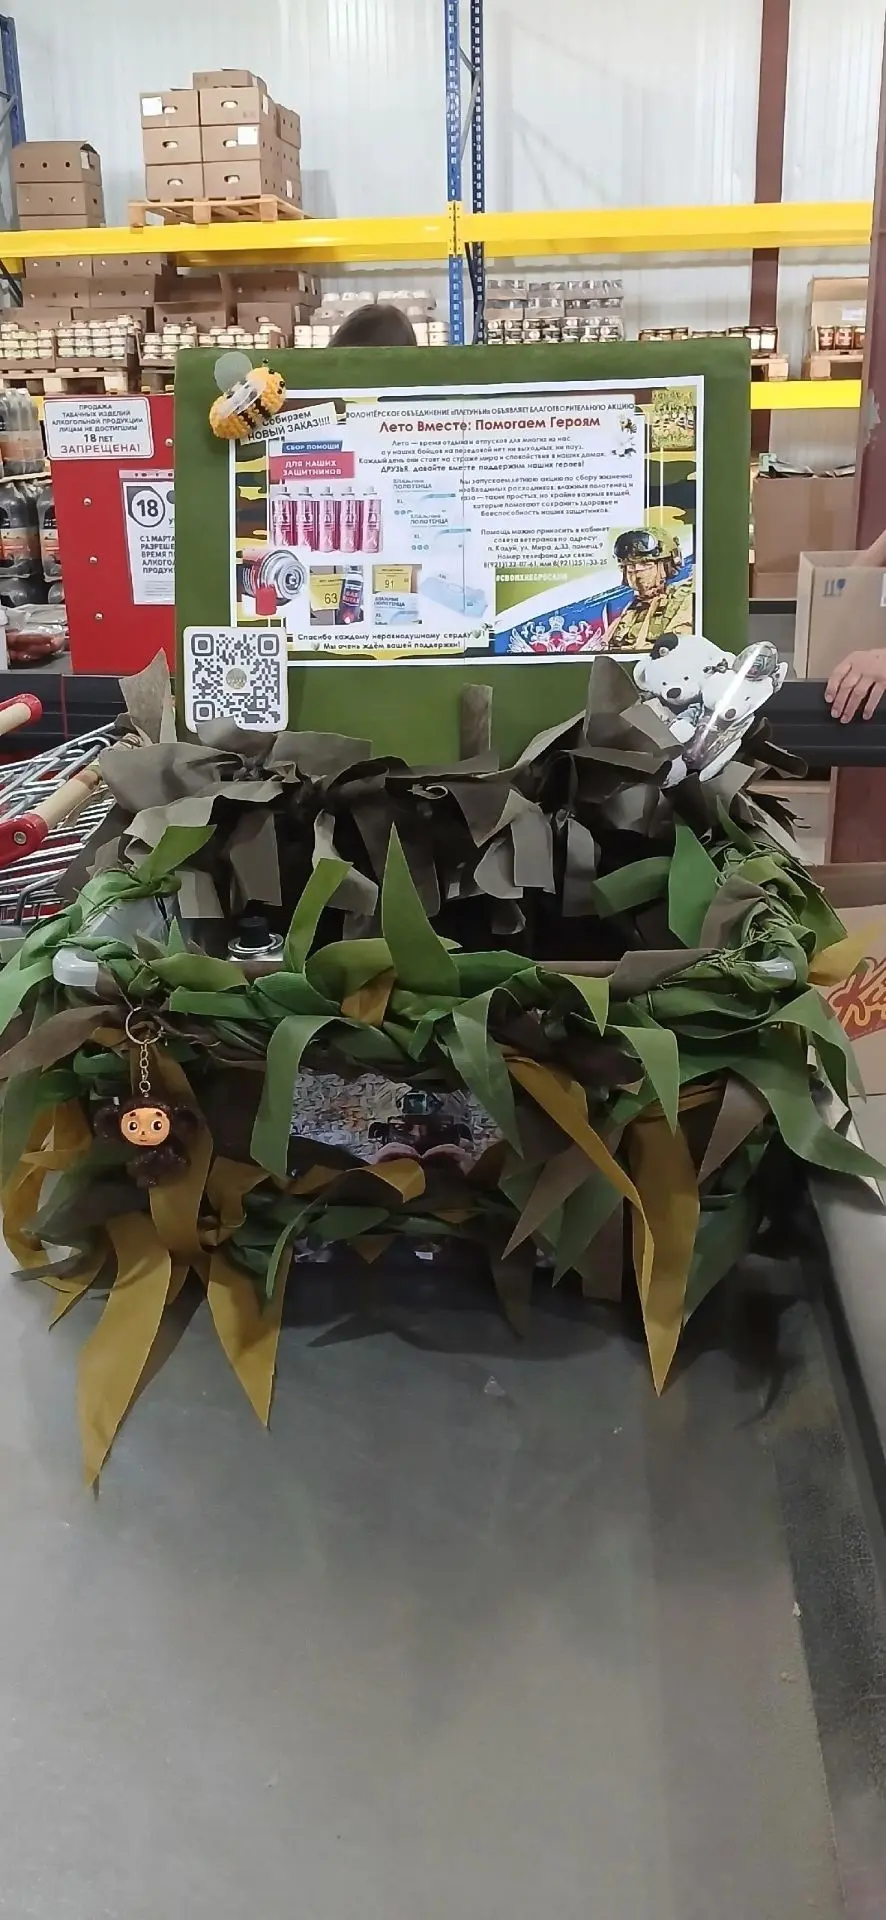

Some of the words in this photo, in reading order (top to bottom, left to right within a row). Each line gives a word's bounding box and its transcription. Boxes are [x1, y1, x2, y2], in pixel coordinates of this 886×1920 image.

[492, 406, 528, 414] ОБЪЯВЛЯЕТ
[529, 404, 606, 412] БЛАГОТВОРИТЕЛЬНУЮ
[248, 426, 286, 440] НОВЫЙ
[287, 416, 330, 433] ЗАКАЗ!!!!
[380, 421, 413, 433] Лето
[417, 420, 472, 432] Вместе:
[476, 418, 546, 430] Помогаем
[550, 416, 600, 430] Героям
[84, 434, 96, 443] 18
[60, 444, 140, 454] ЗАПРЕЩЕНА!
[412, 464, 446, 472] давайте
[555, 460, 585, 469] героев!
[282, 468, 342, 476] ЗАЩИТНИКОВ
[136, 499, 158, 517] 18
[522, 552, 558, 560] телефона
[384, 579, 394, 589] 91
[324, 592, 338, 604] 63
[298, 634, 332, 642] Спасибо
[334, 633, 370, 642] каждому
[372, 632, 440, 641] неравнодушному
[362, 642, 384, 650] ждём
[414, 641, 460, 650] поддержки!
